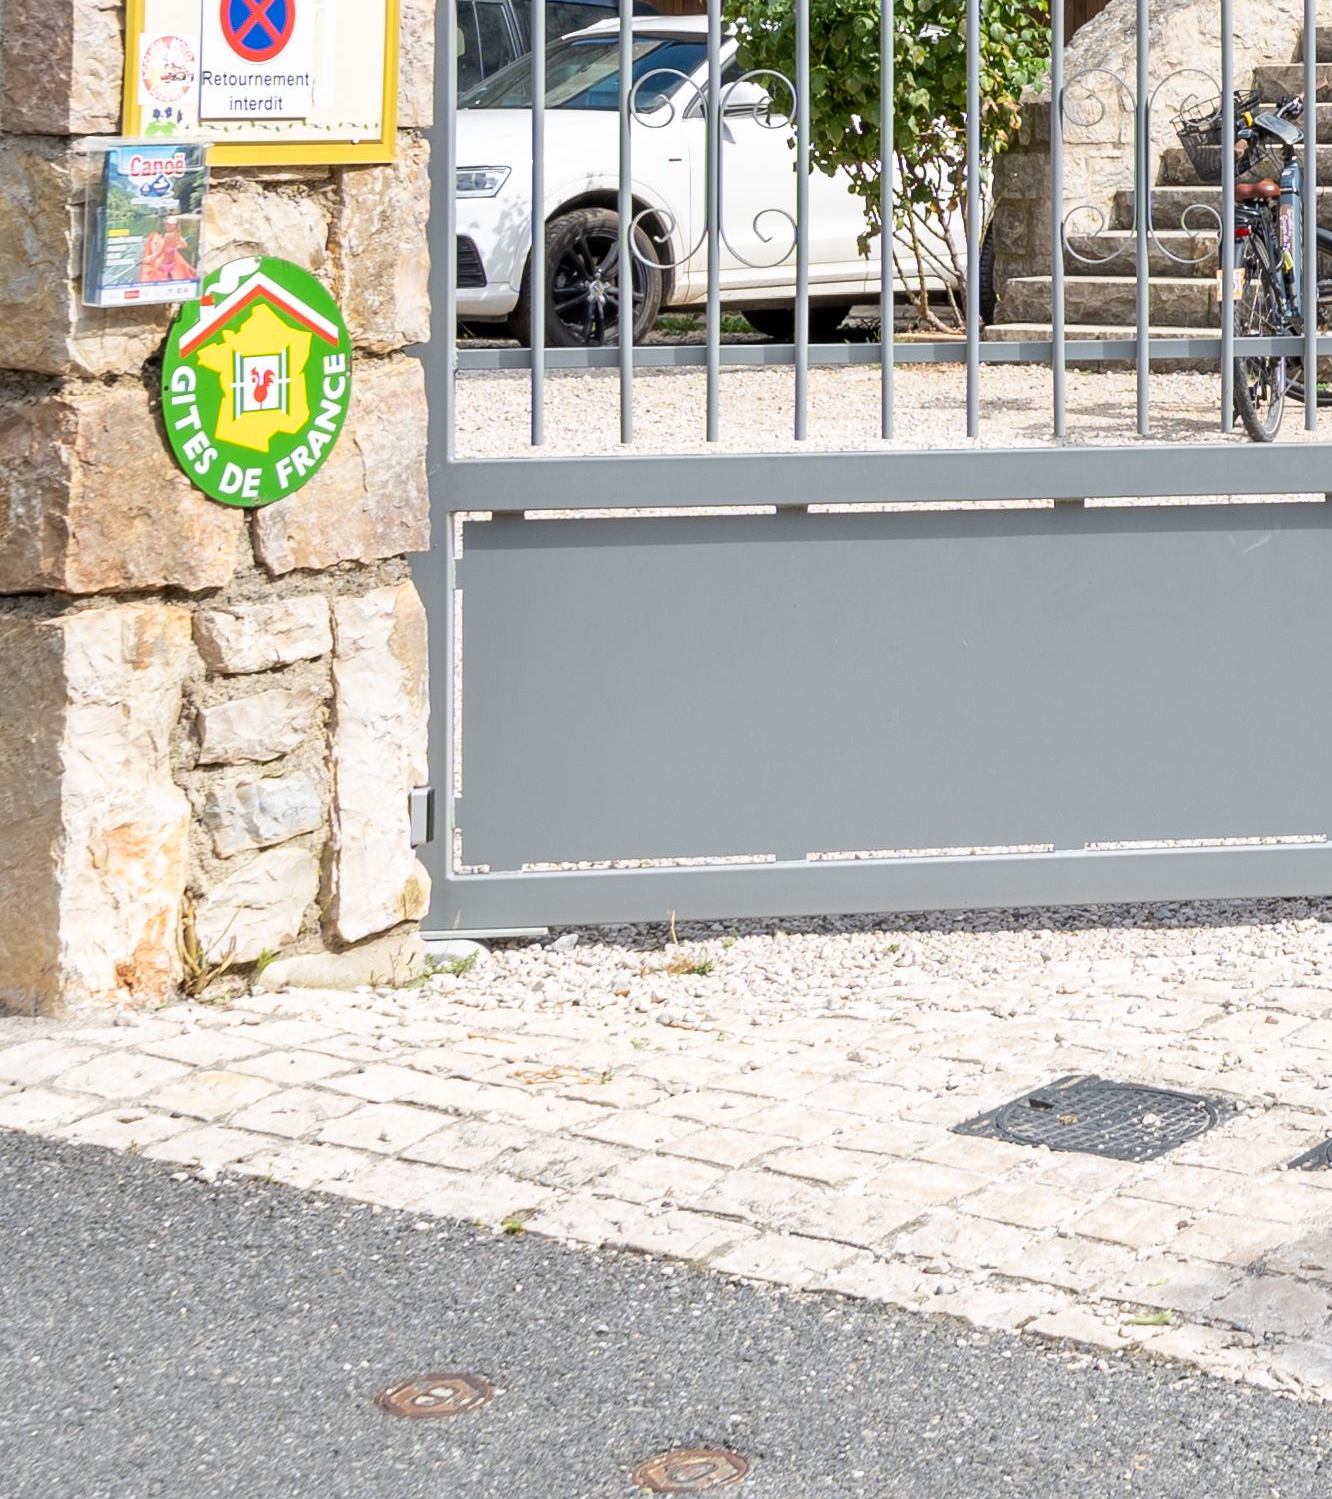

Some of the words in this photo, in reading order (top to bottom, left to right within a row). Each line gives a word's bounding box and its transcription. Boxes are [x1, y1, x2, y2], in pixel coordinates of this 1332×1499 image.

[202, 71, 310, 86] Retournement
[230, 96, 283, 110] interdit
[131, 154, 184, 176] Canoë
[171, 365, 218, 475] GITES
[218, 462, 262, 498] DE
[275, 353, 346, 490] FRANCE
